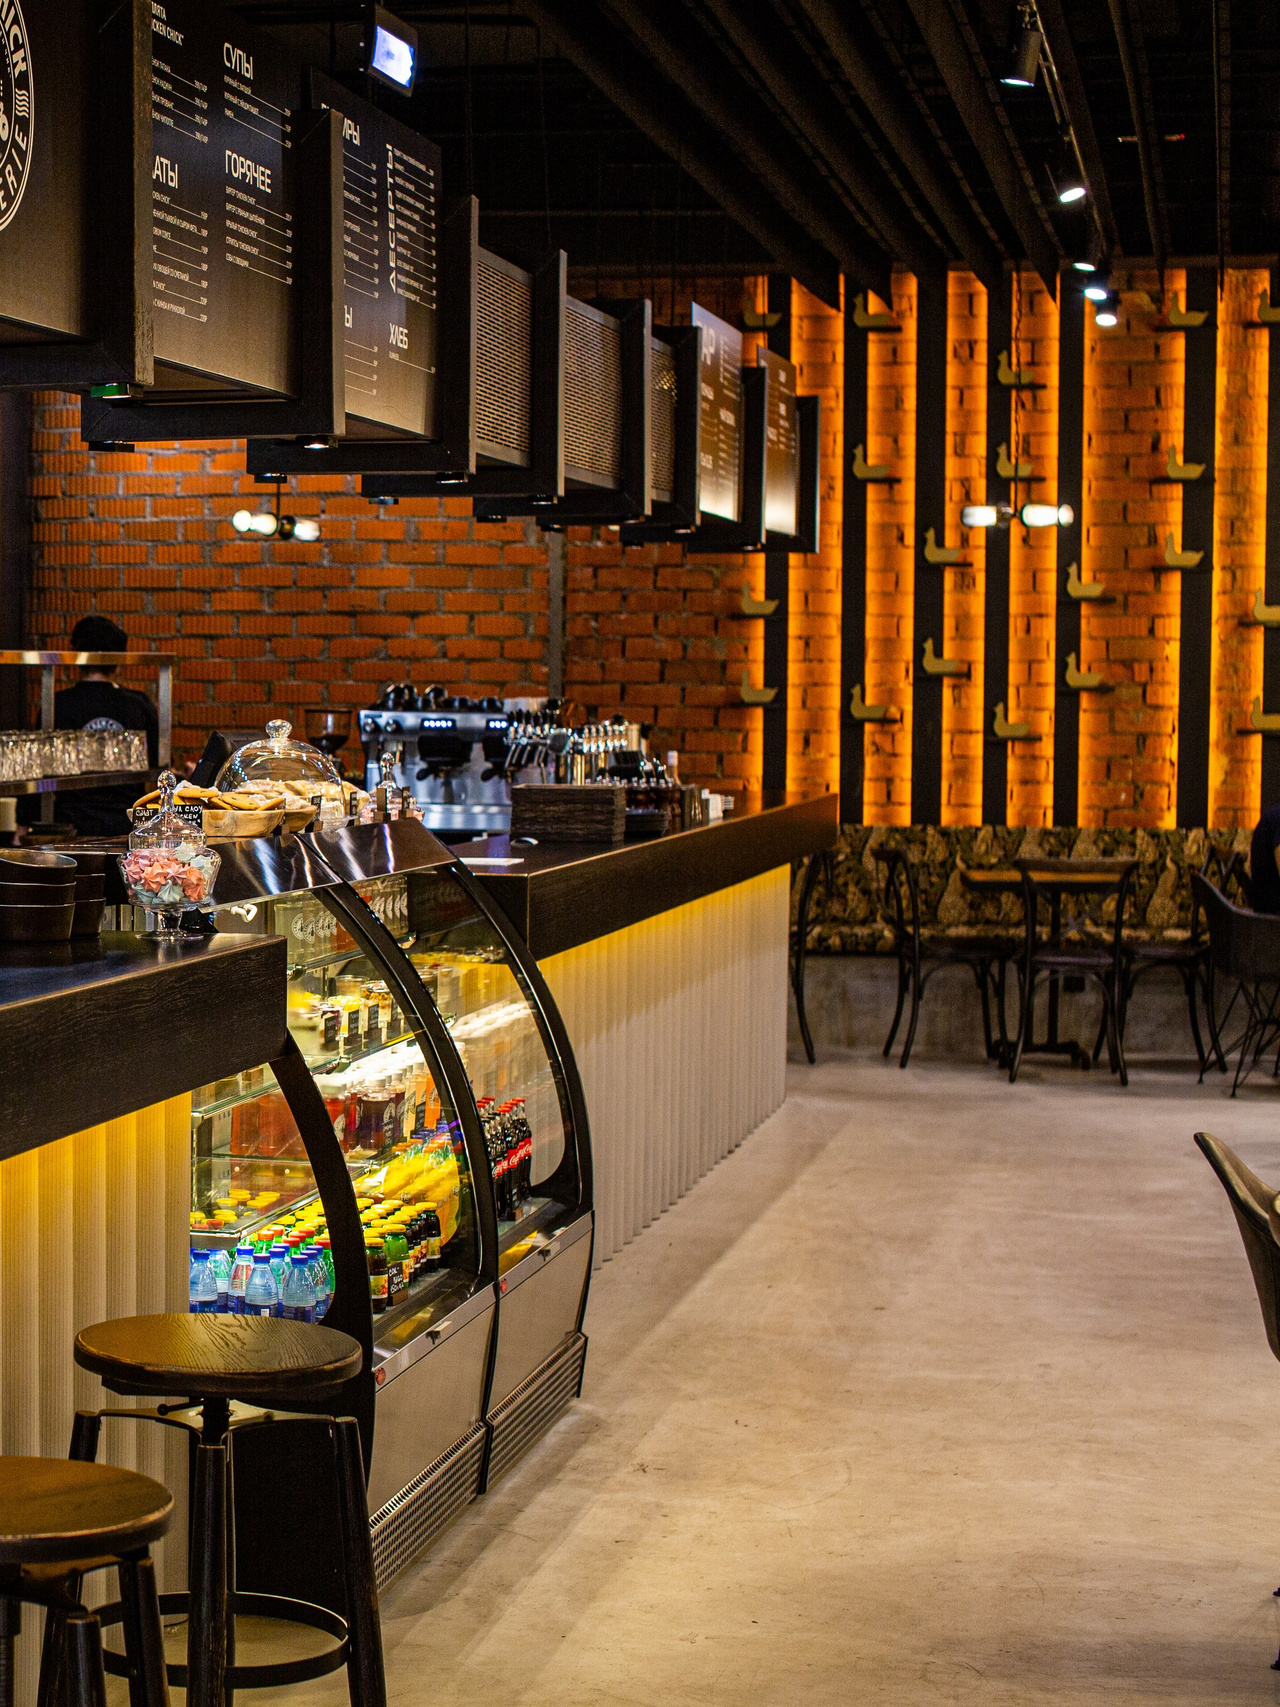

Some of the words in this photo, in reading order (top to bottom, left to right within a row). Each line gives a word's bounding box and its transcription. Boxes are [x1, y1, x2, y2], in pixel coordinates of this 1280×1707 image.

[223, 42, 254, 80] СУПЫ
[151, 155, 179, 189] АТЫ
[225, 149, 272, 194] ГОРЯЧЕЕ
[385, 143, 397, 293] ДЕСЕРТЫ
[344, 305, 353, 329] Ы
[389, 322, 409, 350] ХЛЕБ
